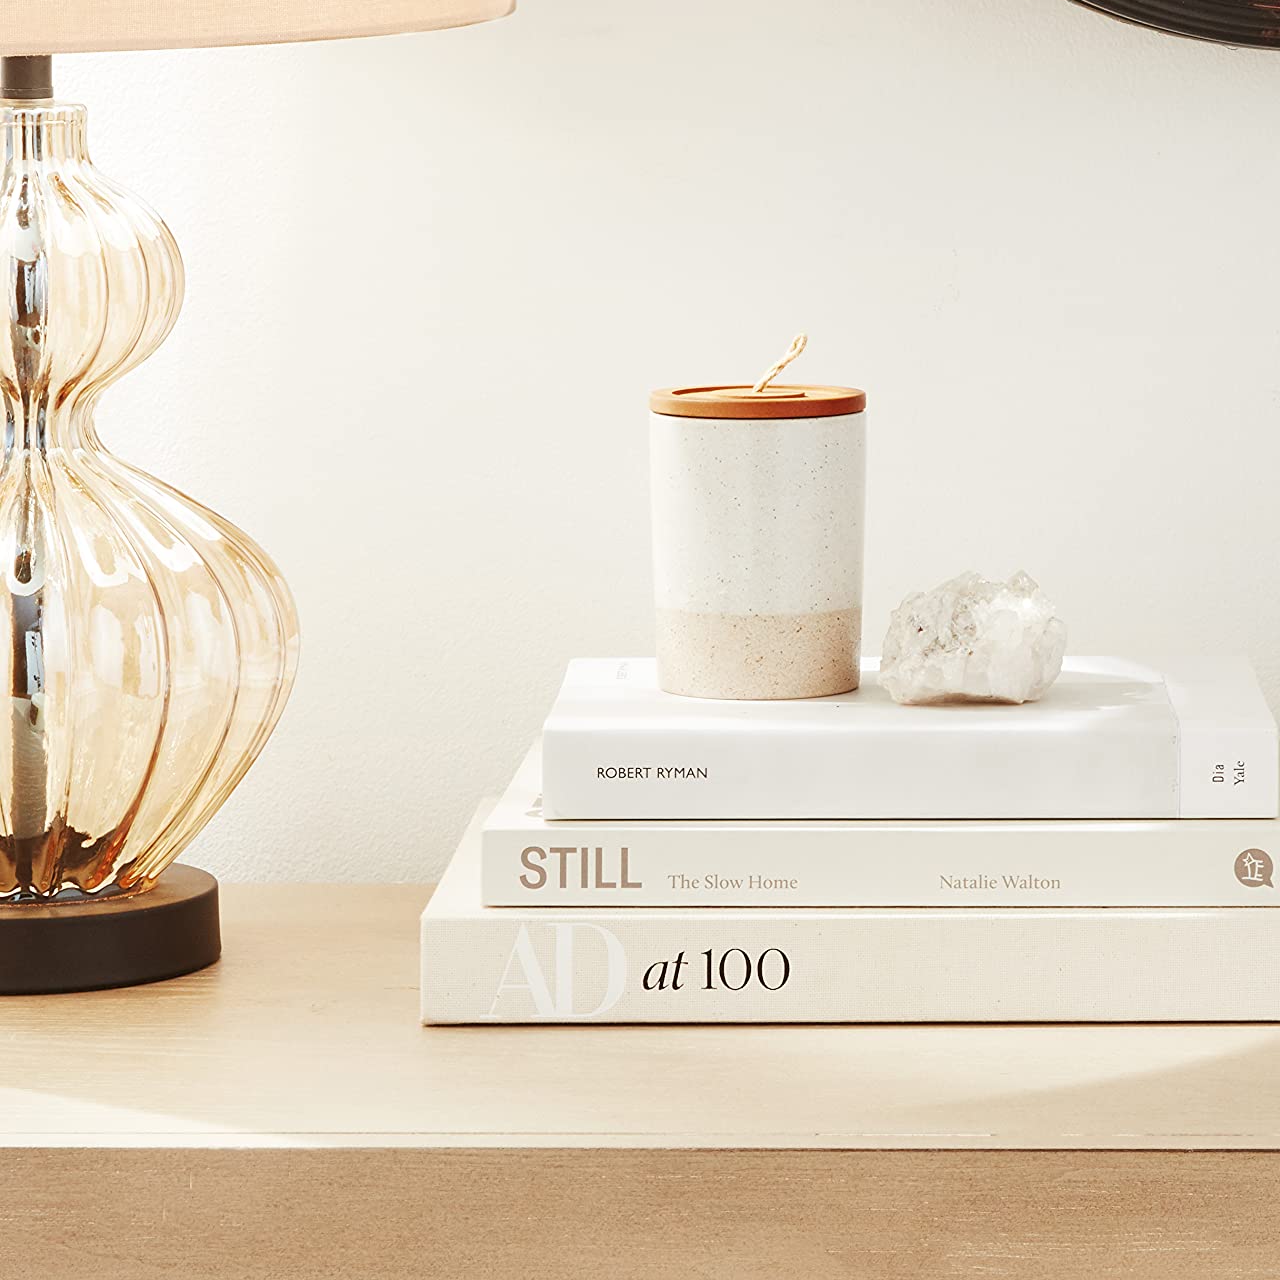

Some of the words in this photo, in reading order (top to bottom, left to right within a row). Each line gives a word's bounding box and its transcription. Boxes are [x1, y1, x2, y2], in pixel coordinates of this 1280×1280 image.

[597, 767, 652, 779] ROBERT
[657, 767, 708, 779] RYMAN
[1212, 762, 1226, 784] Dia
[1232, 759, 1246, 786] Yale
[519, 845, 643, 890] STILL
[667, 873, 700, 890] The
[704, 873, 744, 890] Slow
[748, 873, 799, 890] Home
[939, 873, 998, 890] Natalie
[1001, 873, 1062, 890] Walton
[479, 921, 628, 1020] AD
[641, 947, 690, 992] at
[700, 947, 792, 992] 100
